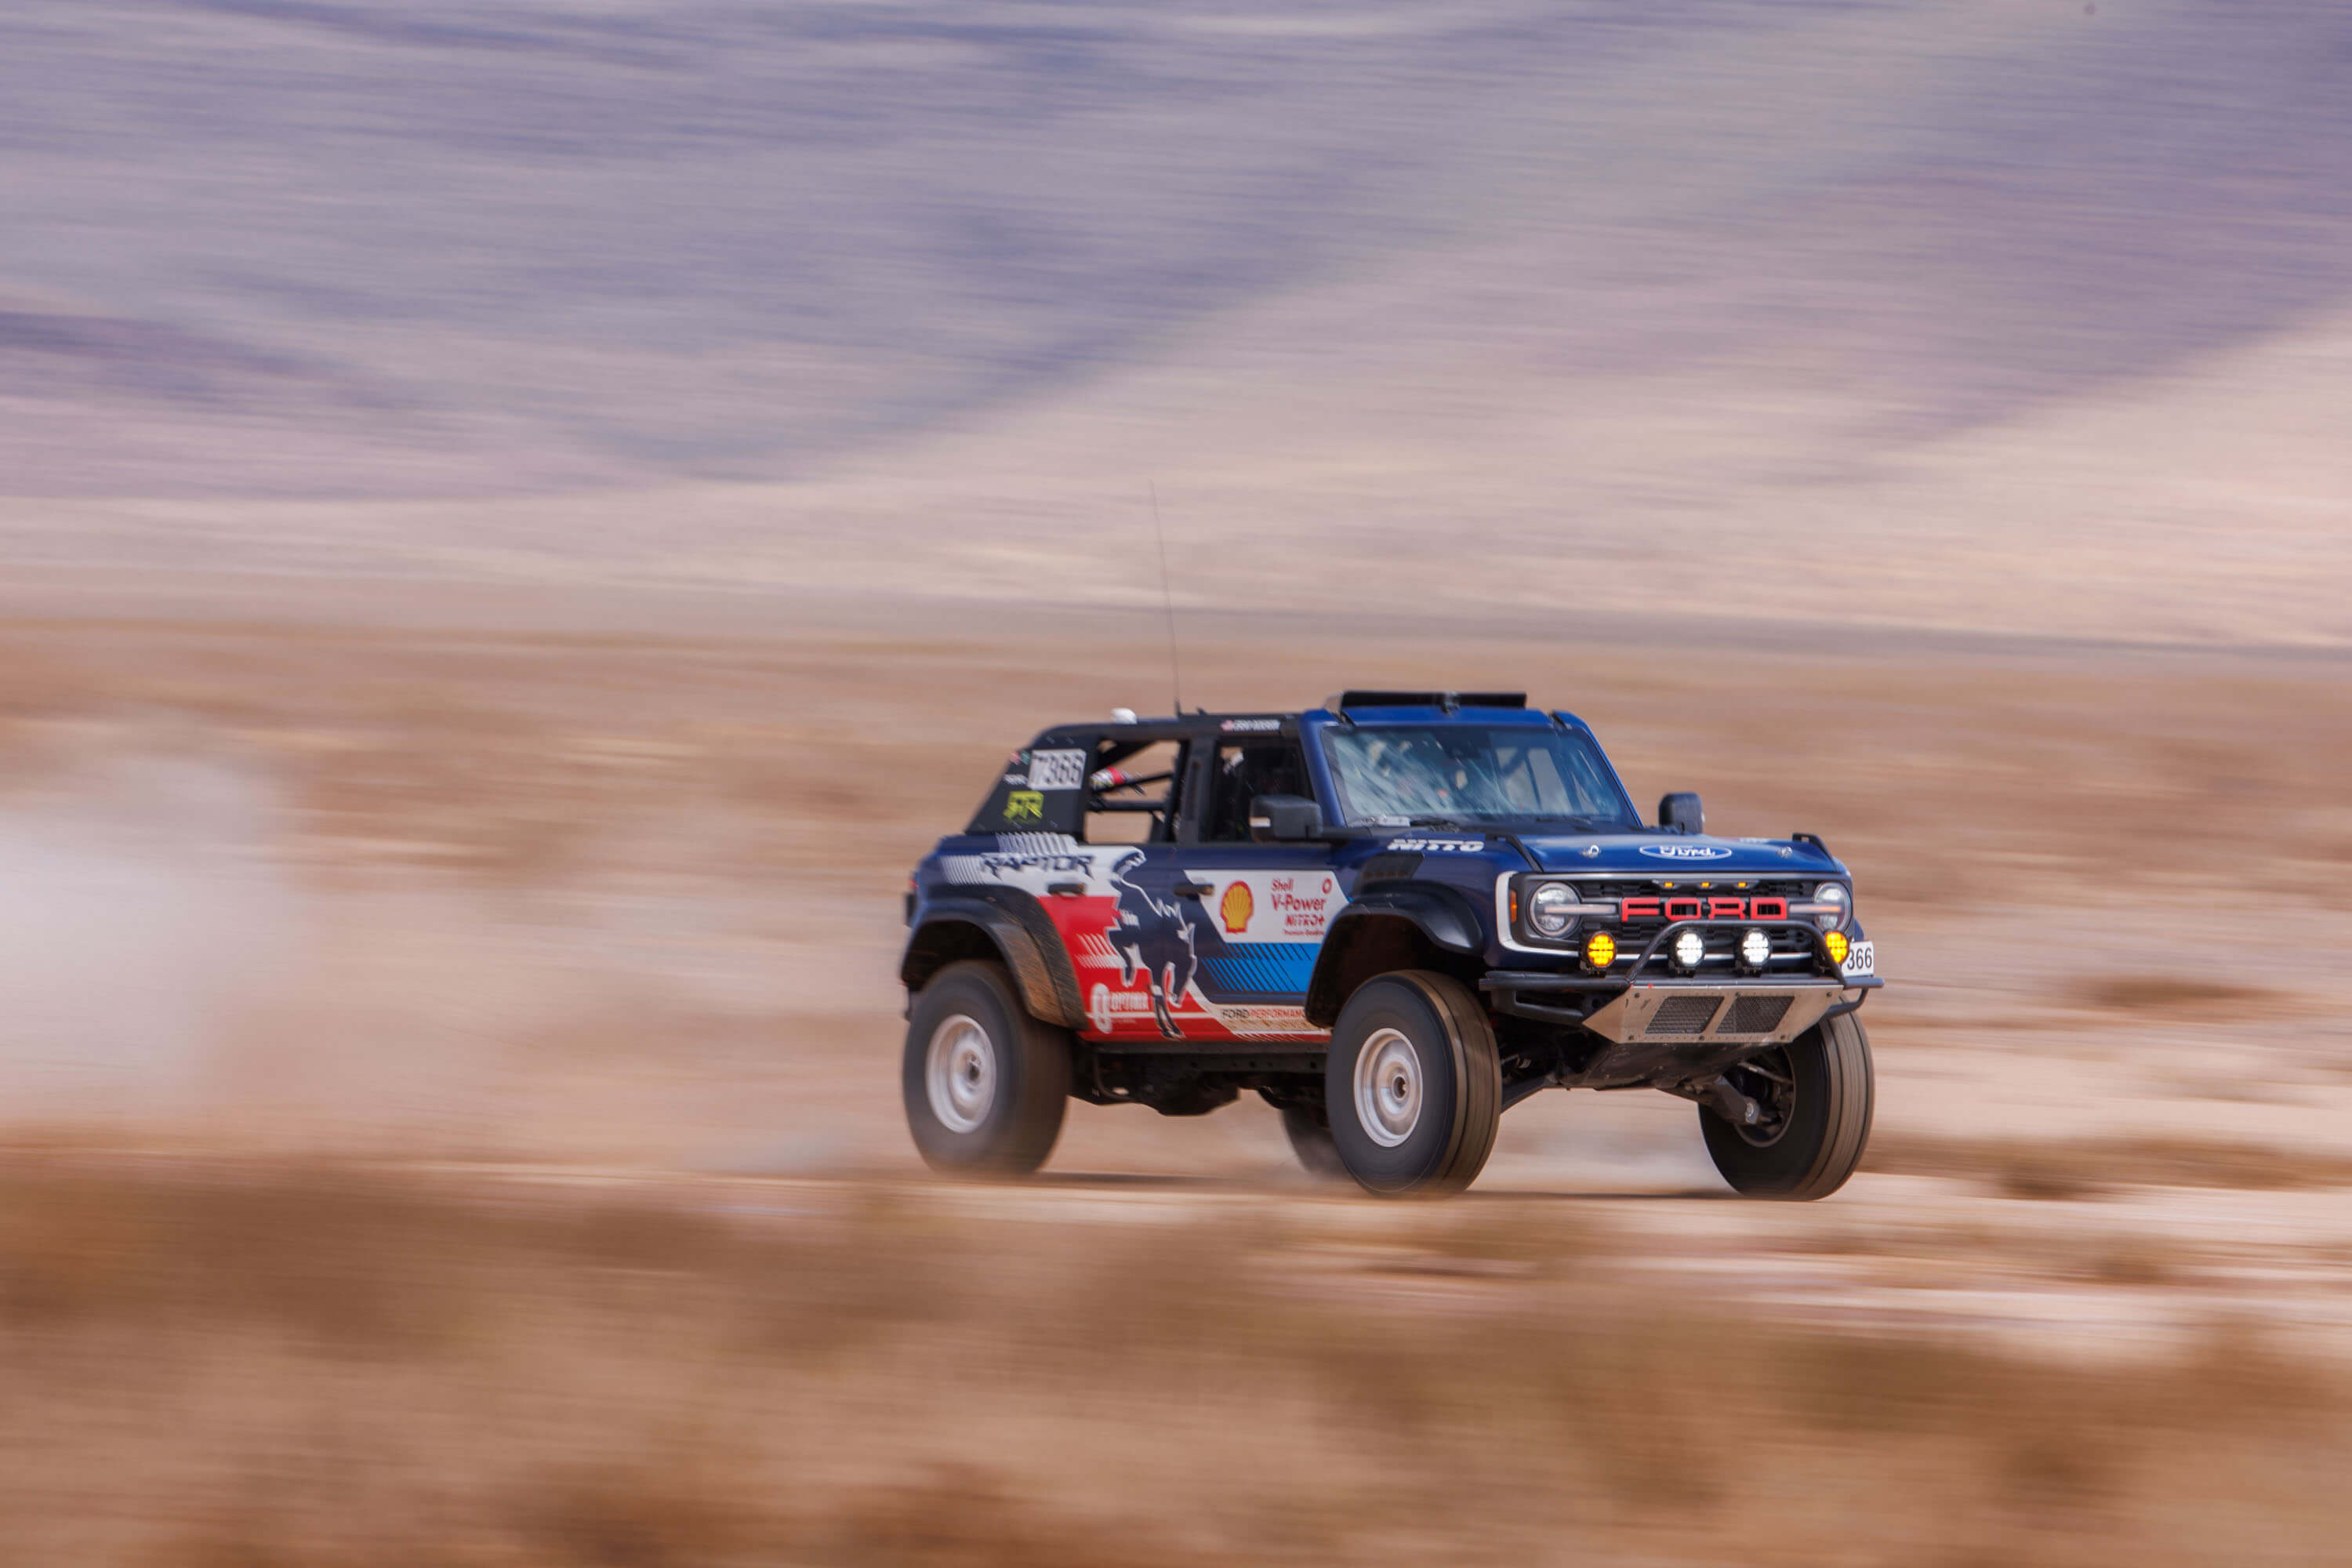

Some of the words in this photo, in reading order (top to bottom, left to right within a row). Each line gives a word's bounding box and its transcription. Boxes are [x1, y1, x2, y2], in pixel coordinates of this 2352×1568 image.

[1387, 838, 1484, 852] NITTO
[1272, 879, 1294, 891] Shell
[1272, 894, 1327, 911] V-Power
[1621, 897, 1787, 922] FORD
[1222, 1009, 1249, 1018] FORD
